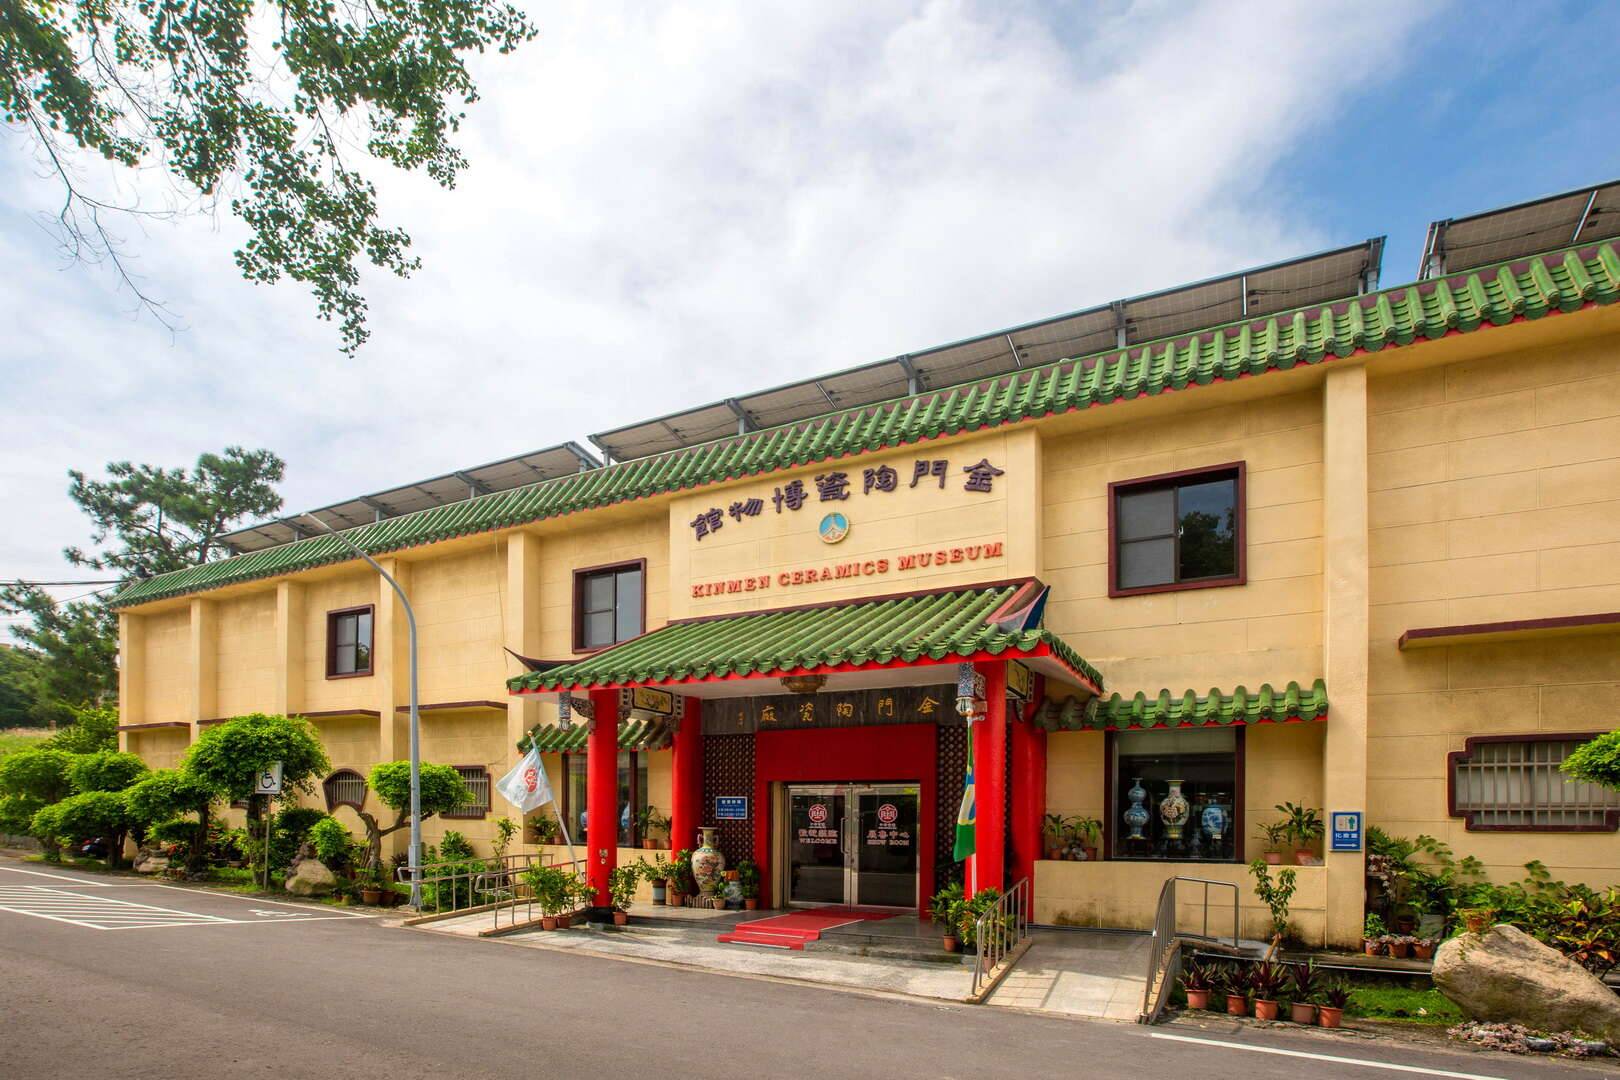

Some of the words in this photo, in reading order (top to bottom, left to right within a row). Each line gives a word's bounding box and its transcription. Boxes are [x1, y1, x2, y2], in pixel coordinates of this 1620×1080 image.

[690, 458, 1005, 541] 金門陶瓷博物館
[691, 575, 770, 598] KINMEN
[778, 558, 889, 587] CERAMICS
[898, 542, 1003, 571] MUSEUM
[761, 696, 940, 722] 金門陶瓷廠
